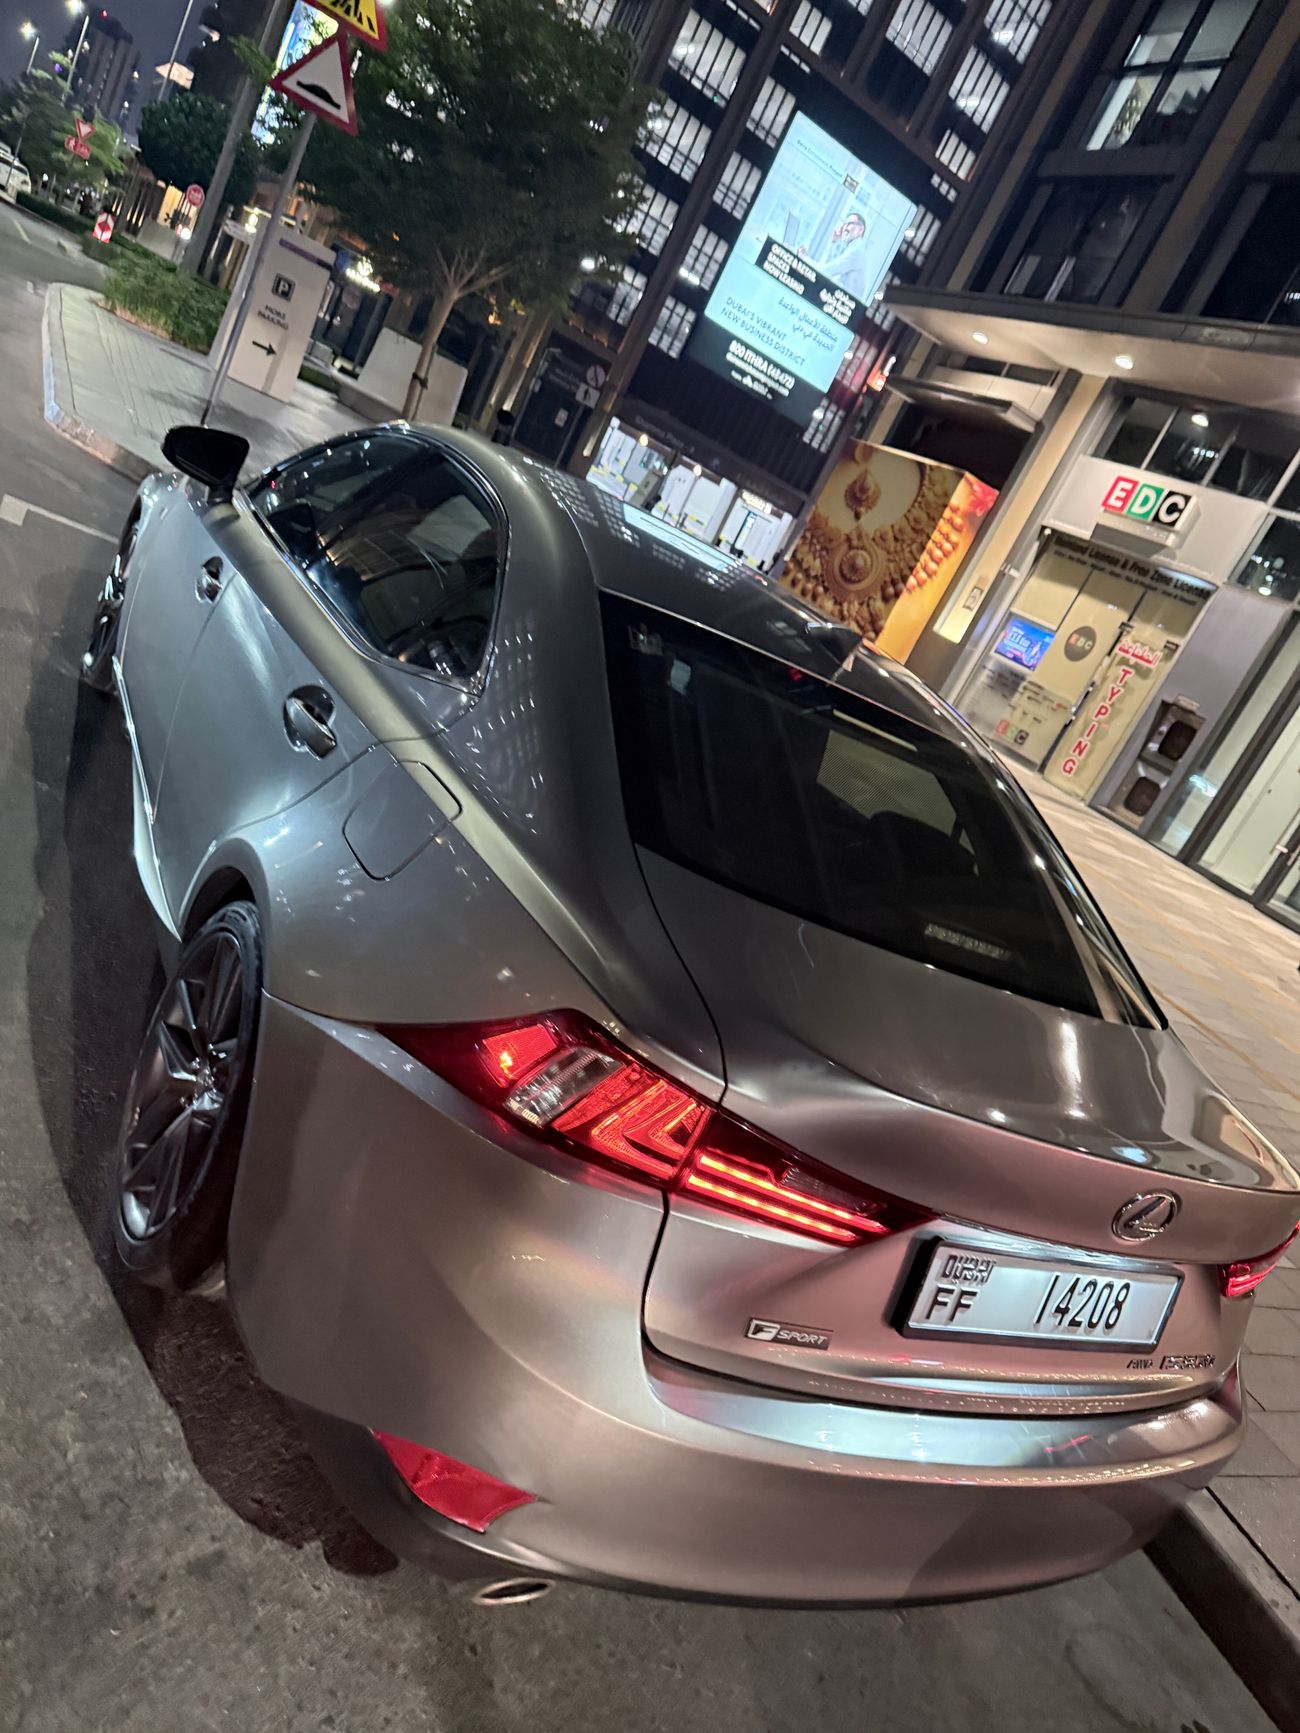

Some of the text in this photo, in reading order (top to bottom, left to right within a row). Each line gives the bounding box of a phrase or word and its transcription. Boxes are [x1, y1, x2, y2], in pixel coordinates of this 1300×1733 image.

[763, 261, 781, 278] NOW
[726, 297, 787, 341] DUBAI'S VIBRANT
[721, 307, 806, 366] NEW BUSINESS DISTRICT
[728, 339, 746, 358] 800
[1106, 480, 1187, 524] EDC
[1129, 561, 1151, 578] Free
[1150, 569, 1173, 586] Zone
[1069, 633, 1093, 650] EDC
[1061, 668, 1133, 775] TYPING
[925, 1272, 1131, 1330] FF 14208
[777, 1329, 828, 1344] SPORT
